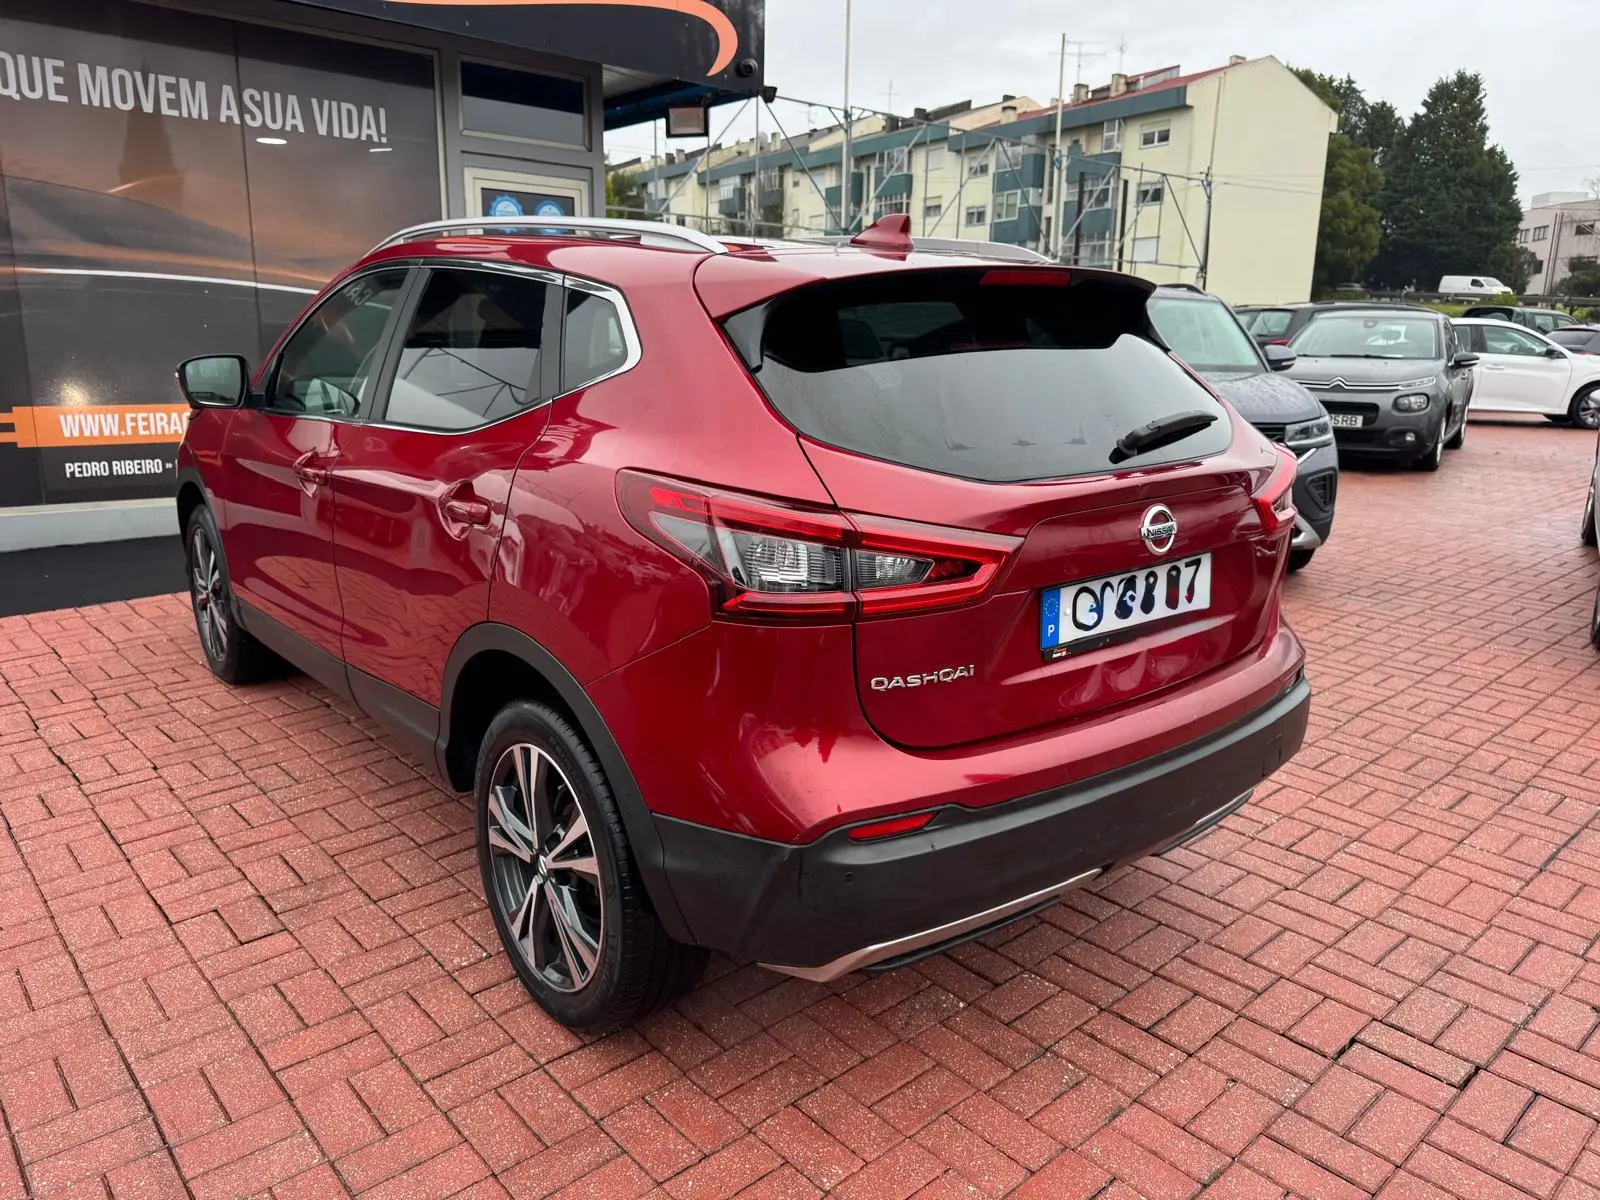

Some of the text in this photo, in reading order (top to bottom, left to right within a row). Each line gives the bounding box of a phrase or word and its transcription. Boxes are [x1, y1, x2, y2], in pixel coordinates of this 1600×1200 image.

[0, 50, 69, 103] QUE
[77, 62, 209, 121] MOVEM
[310, 97, 388, 143] VIDA!
[65, 461, 109, 478] PEDRO
[112, 458, 163, 476] RIBEIRO
